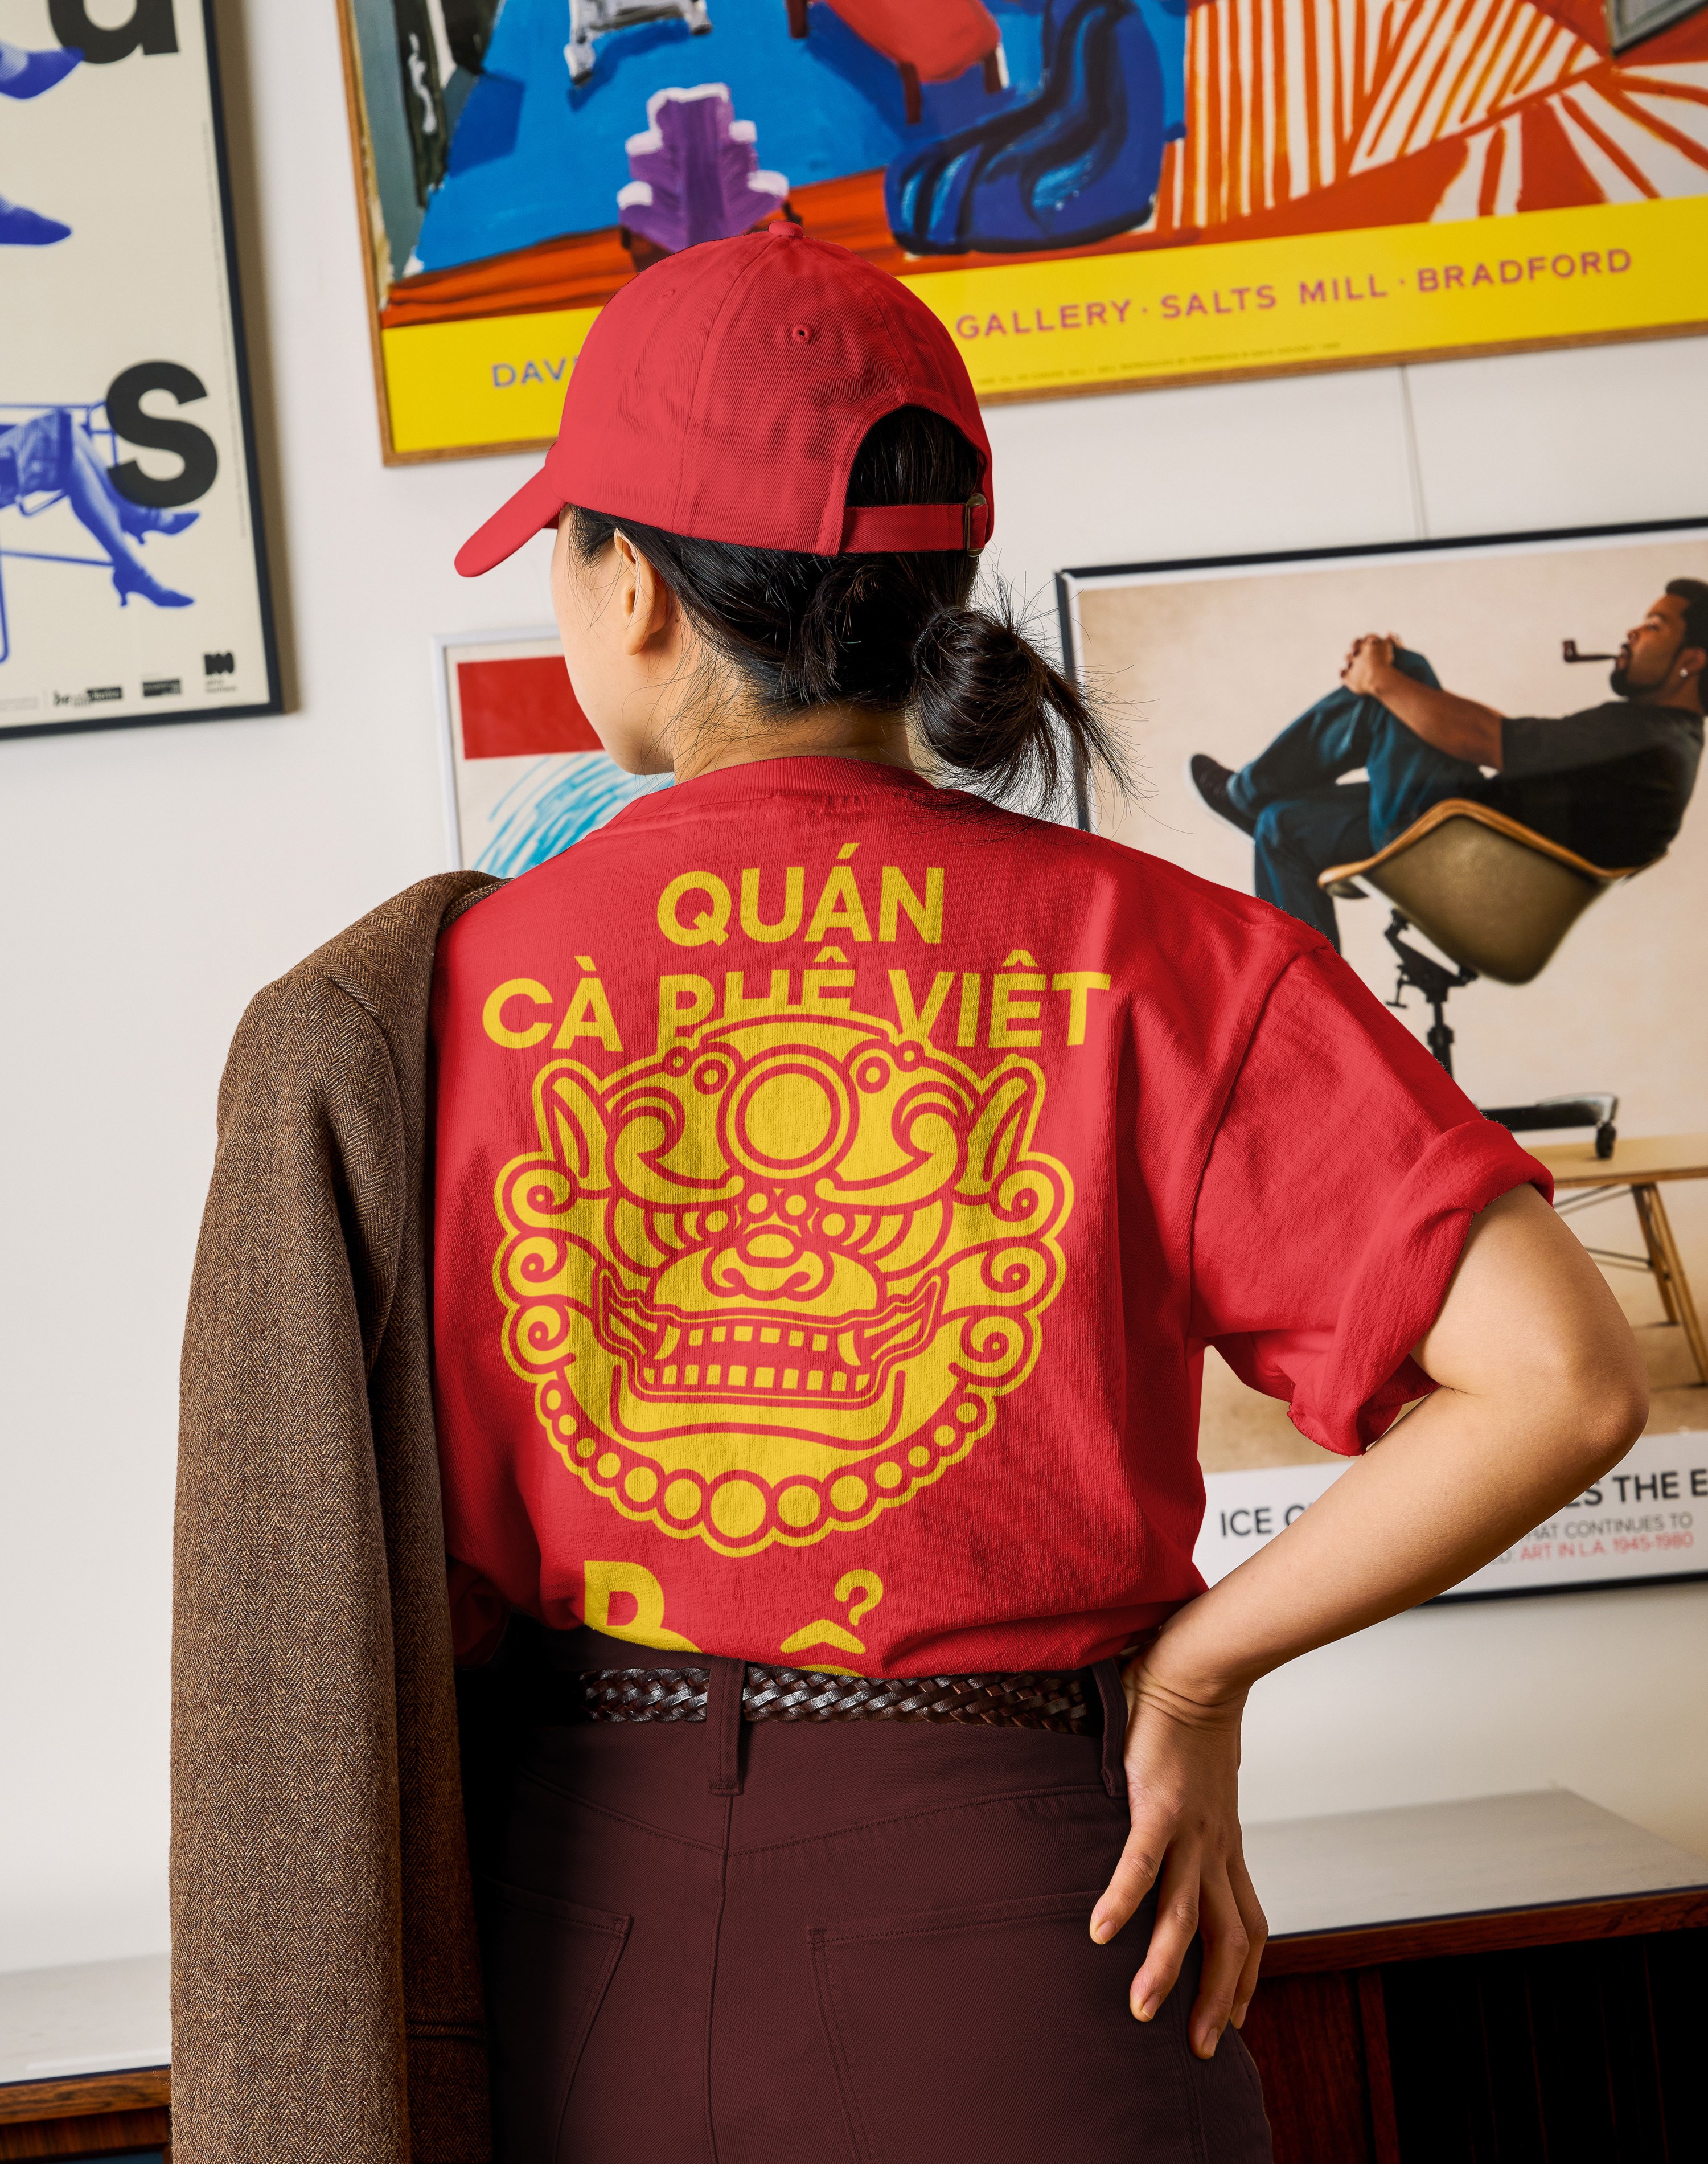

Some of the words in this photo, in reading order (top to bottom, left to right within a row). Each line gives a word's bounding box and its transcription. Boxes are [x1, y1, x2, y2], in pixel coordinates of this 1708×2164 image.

[491, 355, 577, 388] DAV
[955, 298, 1131, 341] GALLERY
[1160, 284, 1277, 319] SALTS
[1299, 274, 1389, 306] MILL
[1417, 248, 1632, 293] BRADFORD
[656, 842, 945, 947] QUÁN
[482, 956, 624, 1052] CÀ
[888, 950, 1111, 1054] VIÊT
[1221, 1505, 1272, 1538] ICE
[1612, 1472, 1680, 1503] THE
[1526, 1522, 1558, 1541] HAT
[1564, 1513, 1665, 1539] CONTINUES
[1669, 1511, 1694, 1530] TO
[1520, 1542, 1551, 1561] ART
[1558, 1541, 1576, 1559] IN
